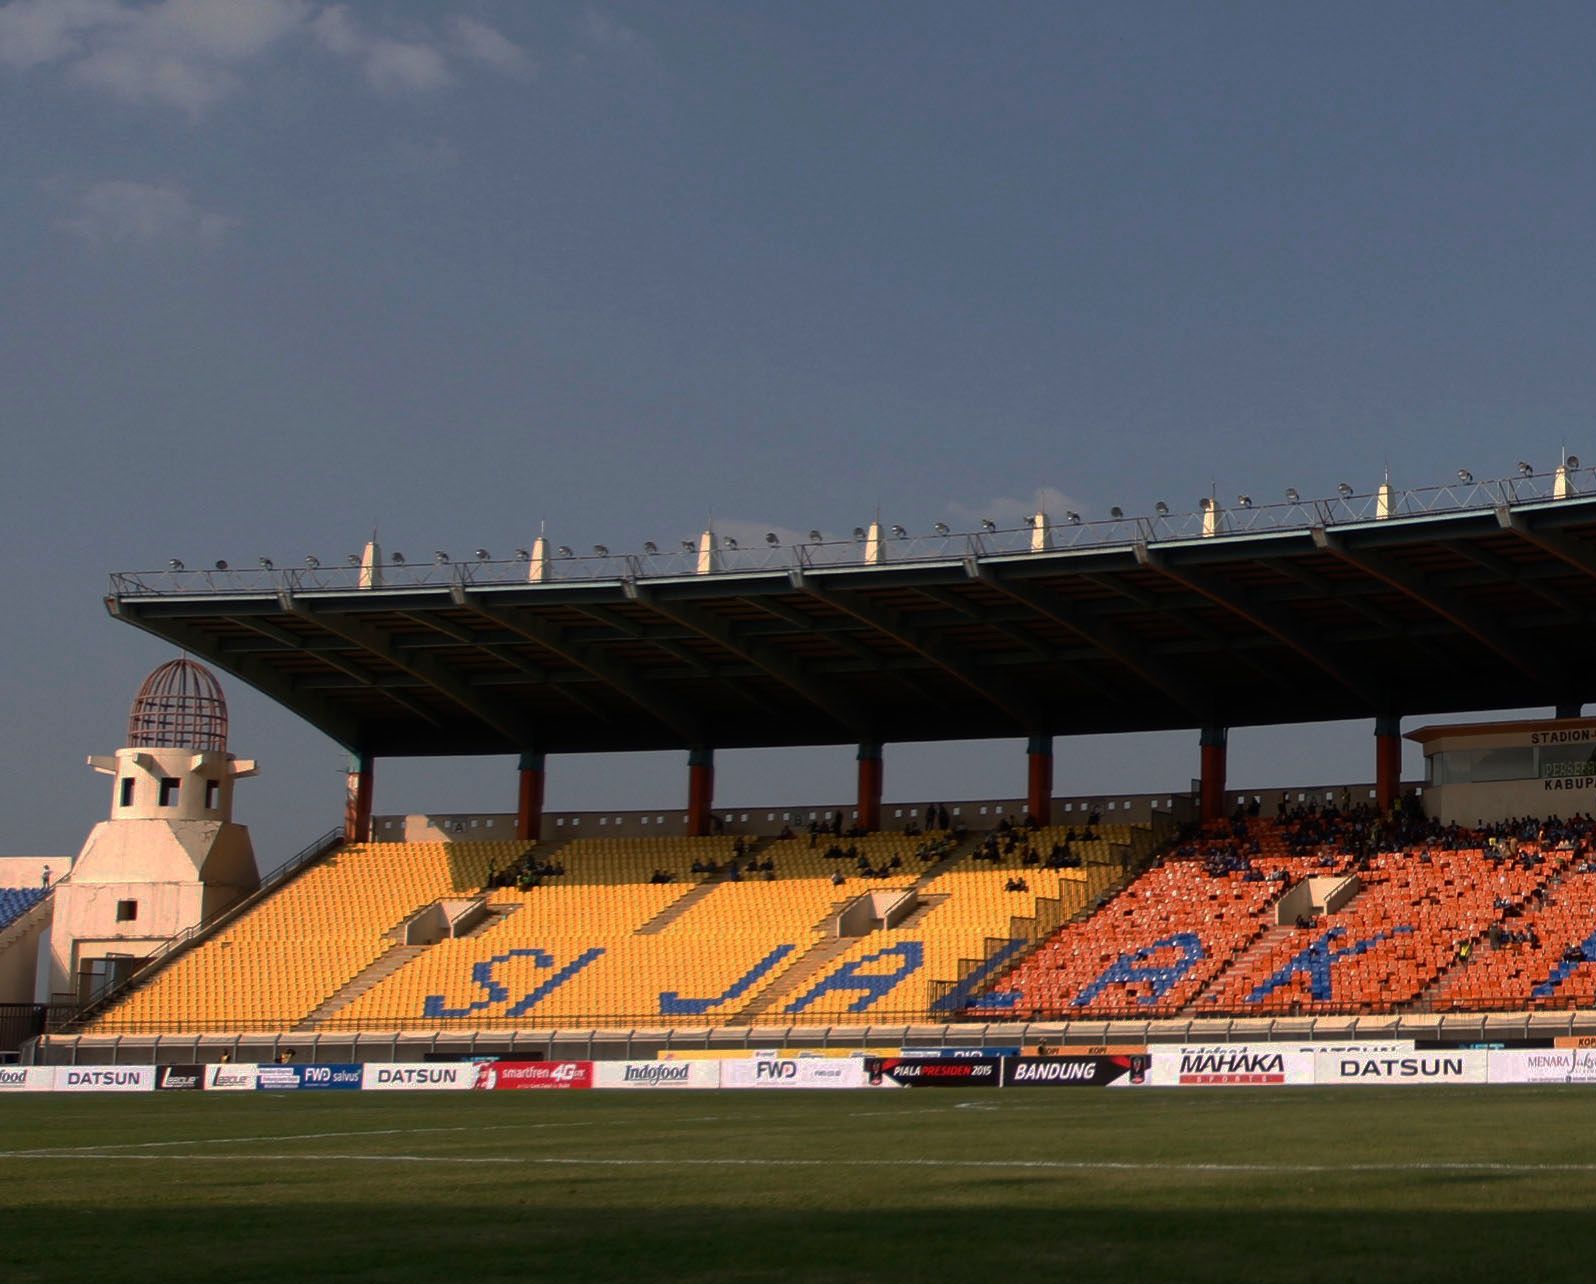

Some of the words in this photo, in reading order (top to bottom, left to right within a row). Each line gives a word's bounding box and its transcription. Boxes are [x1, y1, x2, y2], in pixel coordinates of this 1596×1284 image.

[1532, 730, 1590, 744] STADION
[423, 947, 606, 1018] SI
[1179, 1054, 1285, 1073] MAHAKA
[1340, 1058, 1463, 1077] DATSUN
[1527, 1056, 1570, 1068] MENARA
[305, 1067, 331, 1081] FWD
[378, 1069, 457, 1083] DATSUN
[502, 1066, 550, 1078] smartfren
[624, 1064, 690, 1085] Indofood
[756, 1061, 798, 1078] FWD
[893, 1066, 920, 1076] PIALA
[920, 1065, 971, 1076] PRESIDEN
[971, 1065, 992, 1076] 2015
[1014, 1062, 1097, 1081] BANDUNG
[68, 1071, 140, 1085] DATSUN
